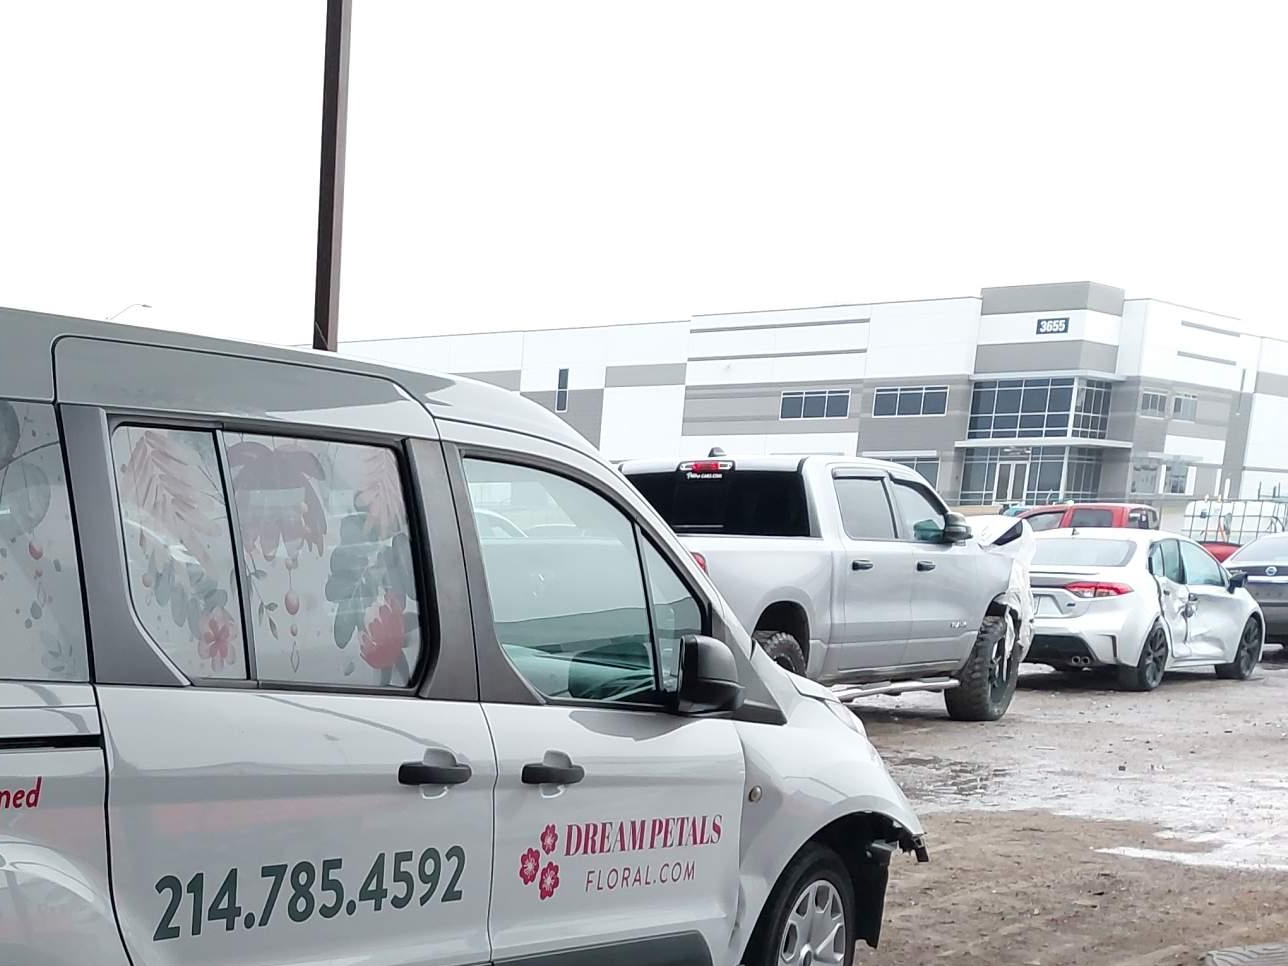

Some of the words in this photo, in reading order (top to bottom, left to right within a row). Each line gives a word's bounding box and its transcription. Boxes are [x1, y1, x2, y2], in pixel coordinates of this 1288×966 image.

[1039, 319, 1066, 333] 3655
[585, 861, 696, 892] FLORAL.COM
[152, 845, 466, 942] 214.785.4592
